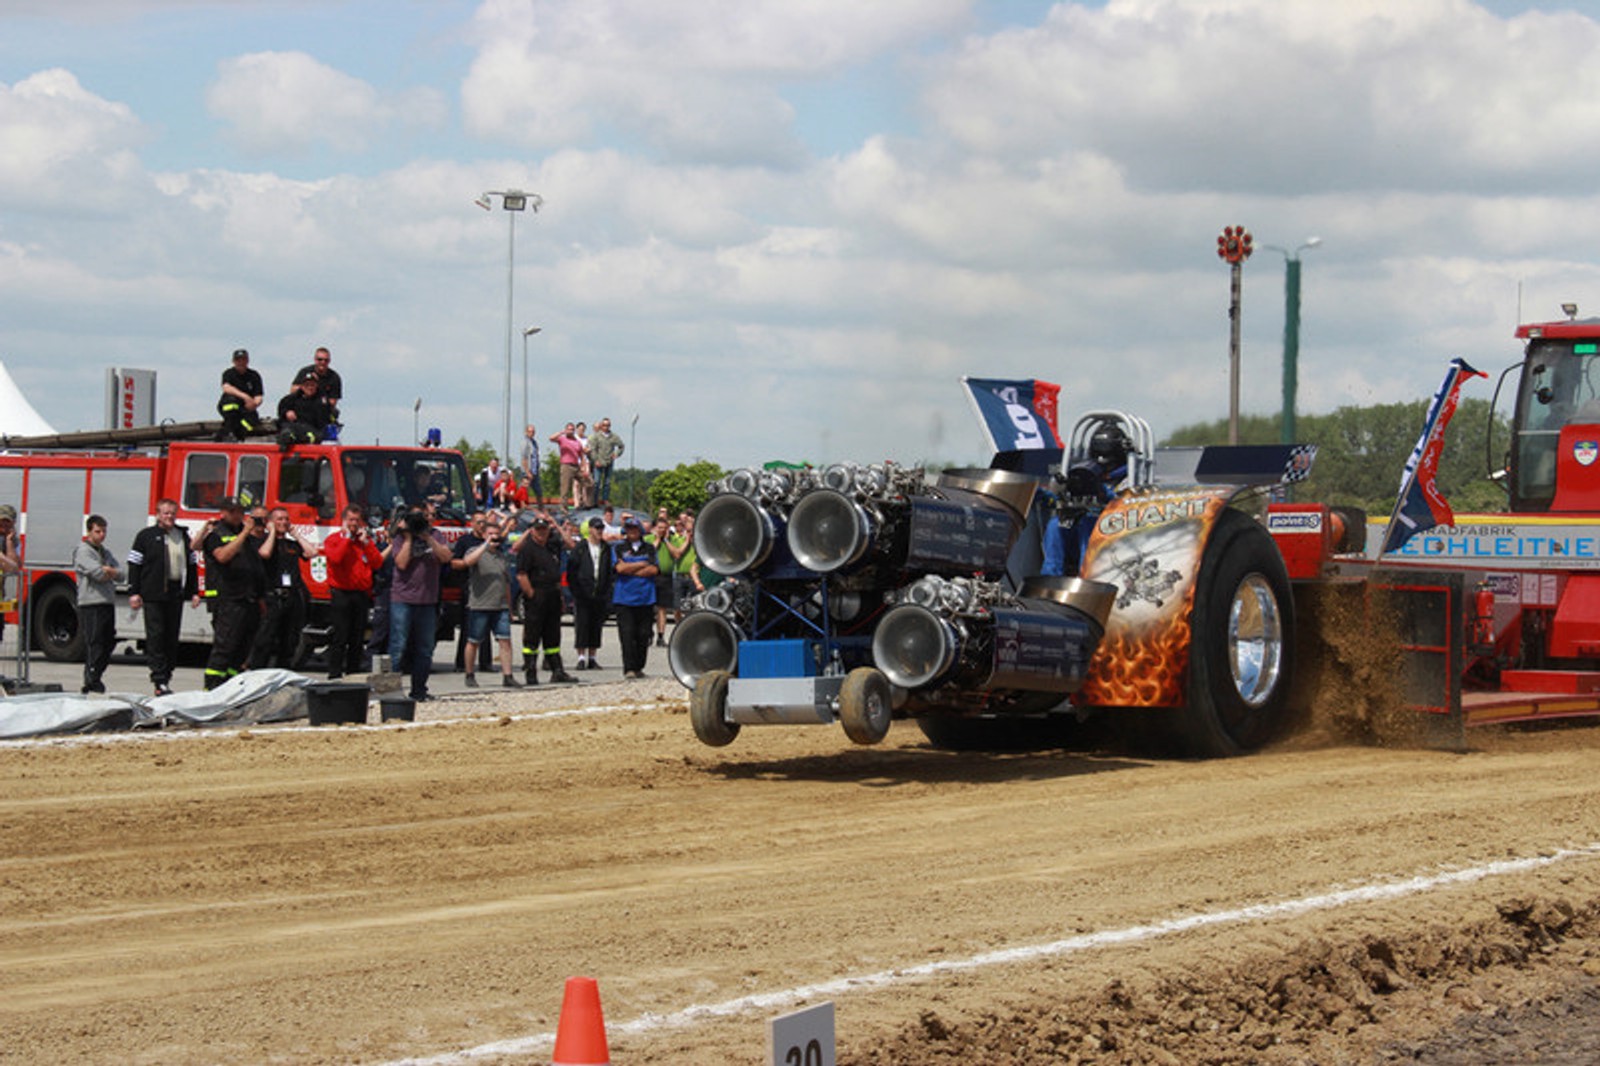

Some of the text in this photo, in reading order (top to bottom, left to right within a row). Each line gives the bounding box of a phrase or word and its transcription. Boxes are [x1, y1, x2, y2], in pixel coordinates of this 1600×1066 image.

[1099, 497, 1210, 534] GIANT
[1420, 525, 1517, 537] RADFABRIK
[1392, 536, 1600, 556] ECHLEITNE
